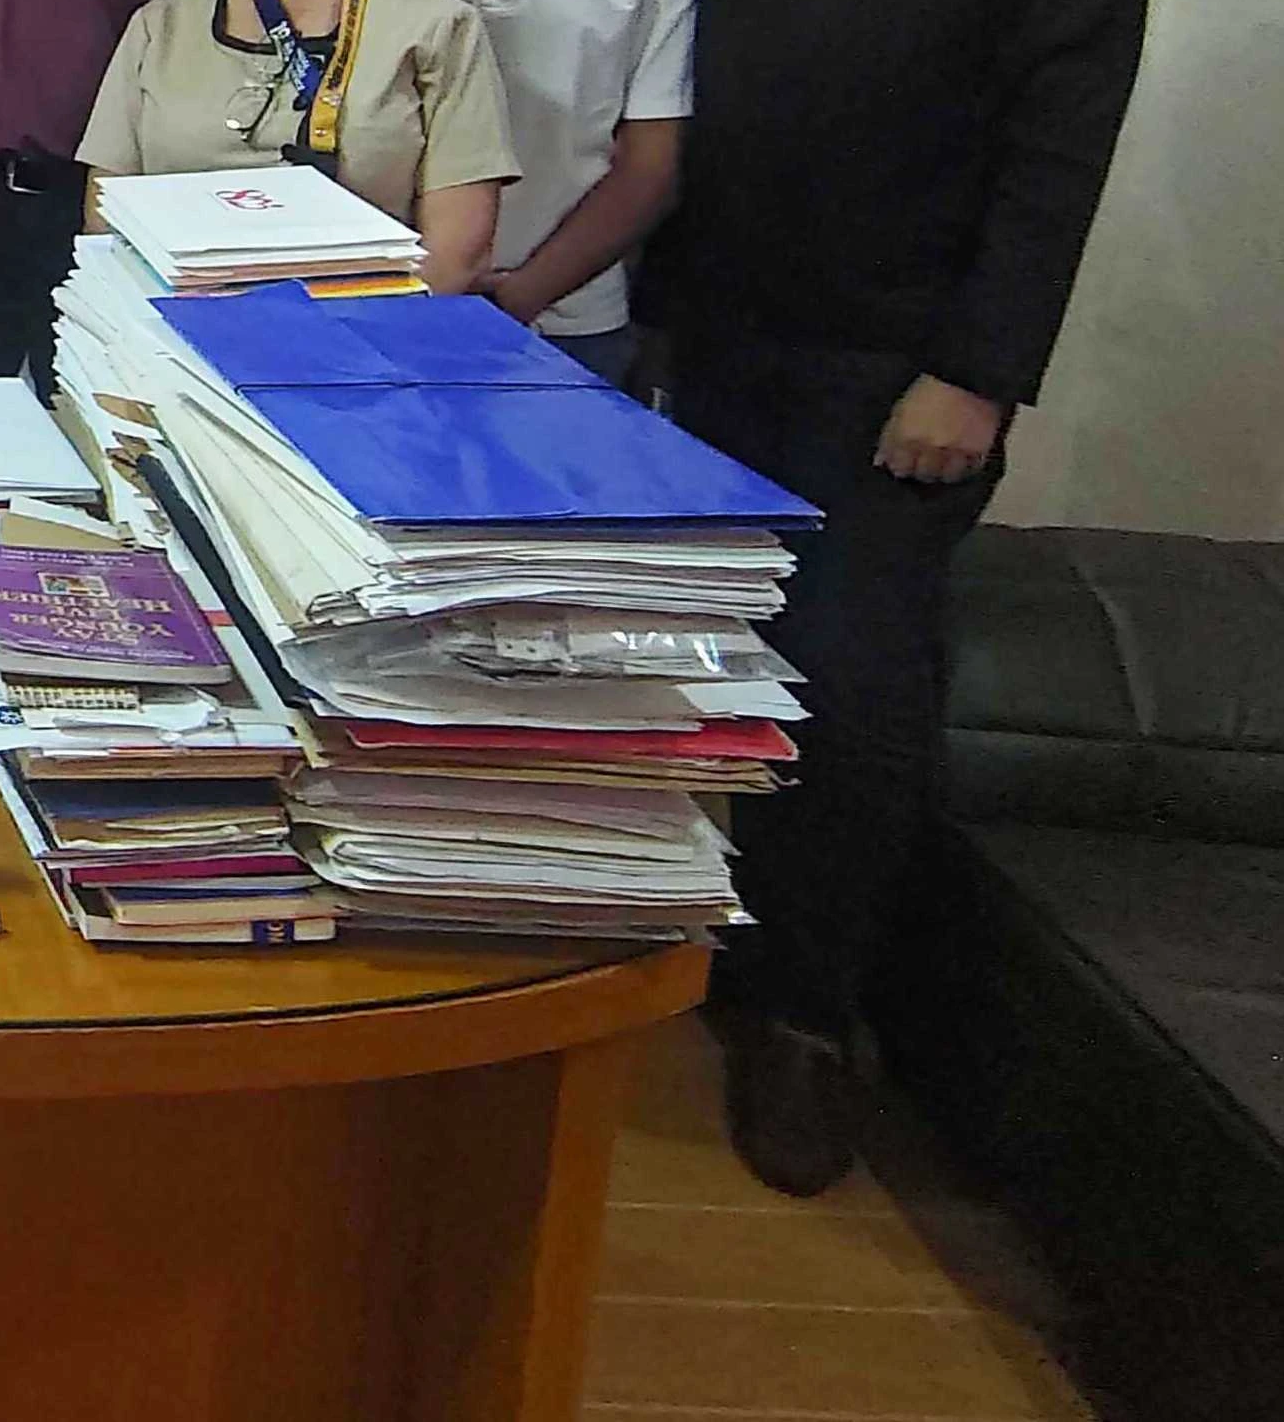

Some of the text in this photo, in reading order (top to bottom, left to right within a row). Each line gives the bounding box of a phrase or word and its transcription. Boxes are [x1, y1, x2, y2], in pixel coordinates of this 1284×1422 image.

[47, 604, 122, 622] LIVE
[8, 612, 175, 639] YOUNGER
[54, 626, 139, 646] STAY
